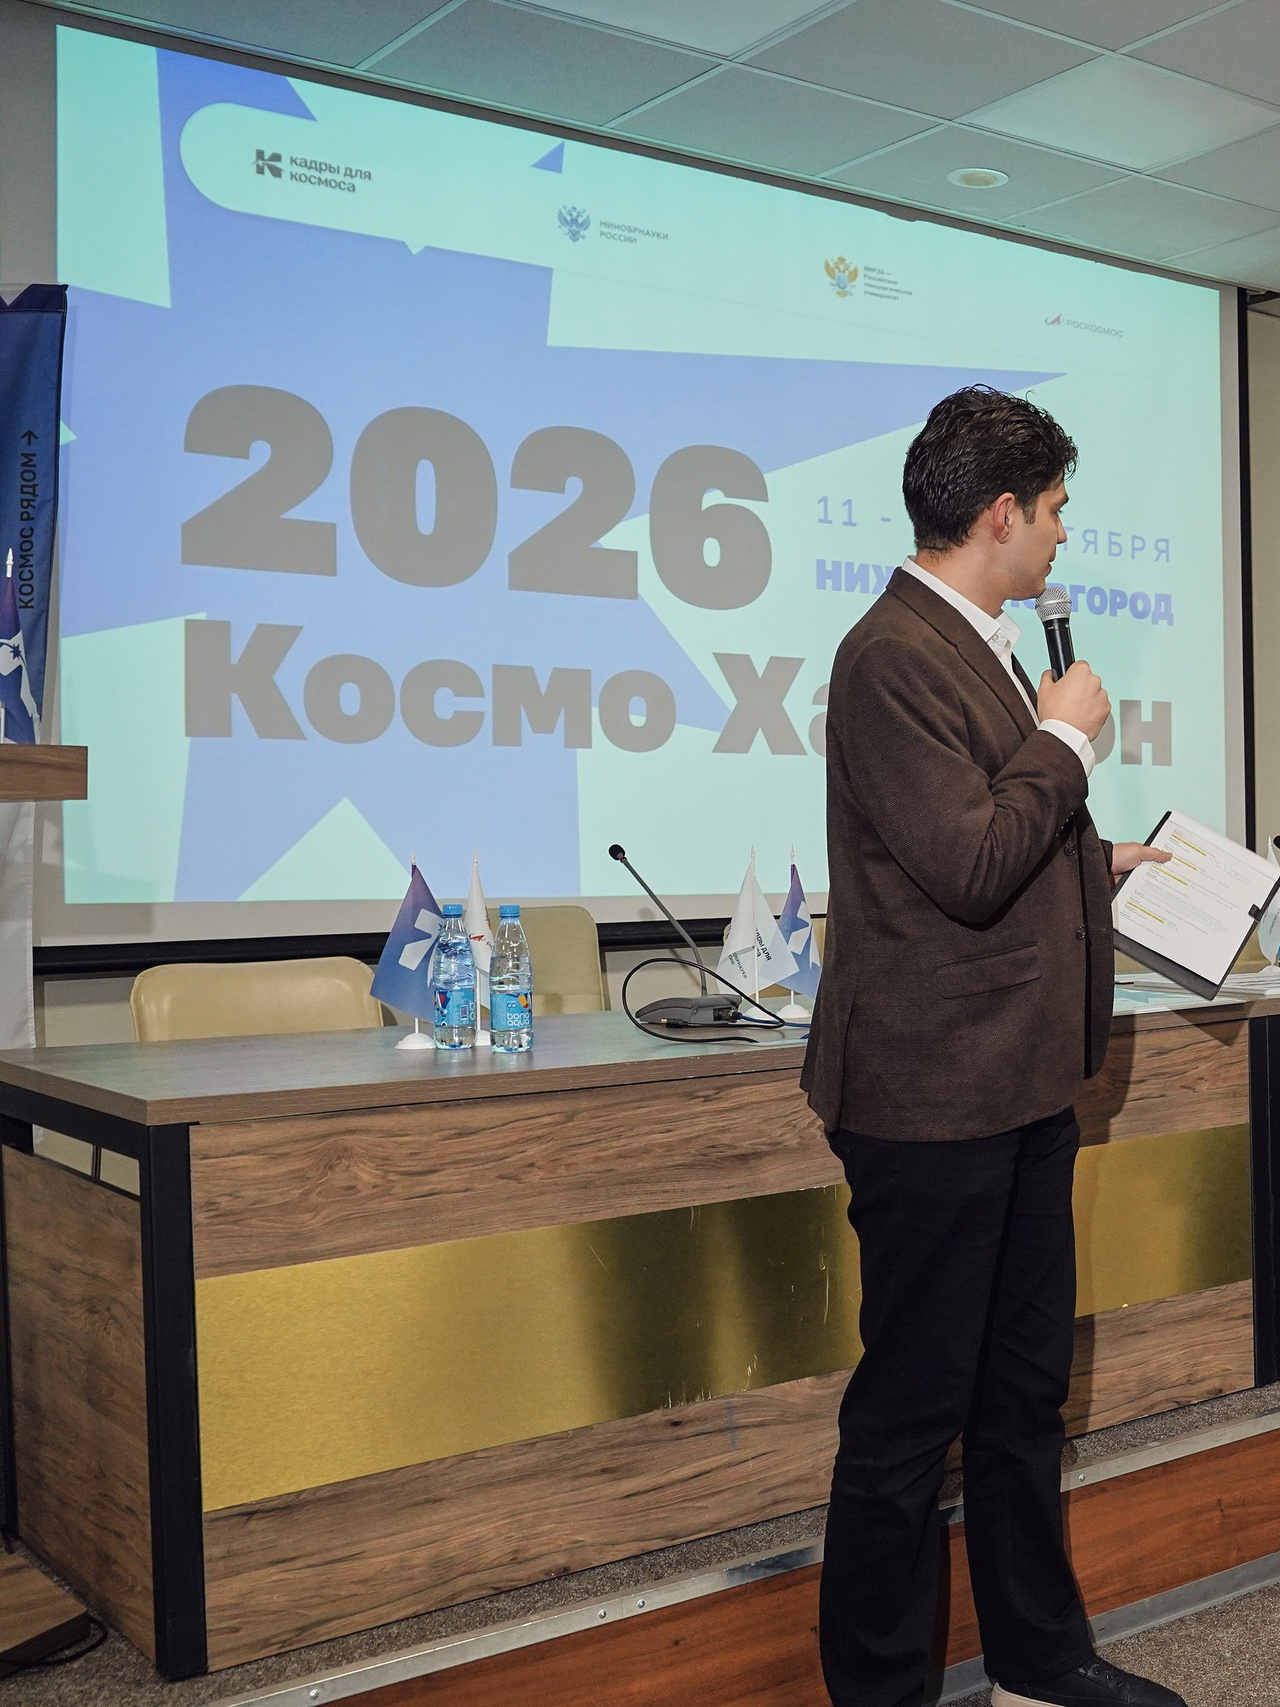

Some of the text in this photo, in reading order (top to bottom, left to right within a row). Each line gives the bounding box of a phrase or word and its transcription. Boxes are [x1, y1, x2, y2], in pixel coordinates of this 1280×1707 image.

[289, 156, 372, 180] кадры для
[289, 171, 356, 192] космоса
[600, 221, 669, 240] МИНОБРНАУКИ
[600, 231, 637, 243] РОССИИ
[1066, 319, 1124, 338] РОСКОСМОС
[181, 384, 773, 610] 2026
[818, 496, 857, 527] 11
[19, 452, 38, 609] КОСМОС РЯДОМ
[184, 618, 677, 754] Космо
